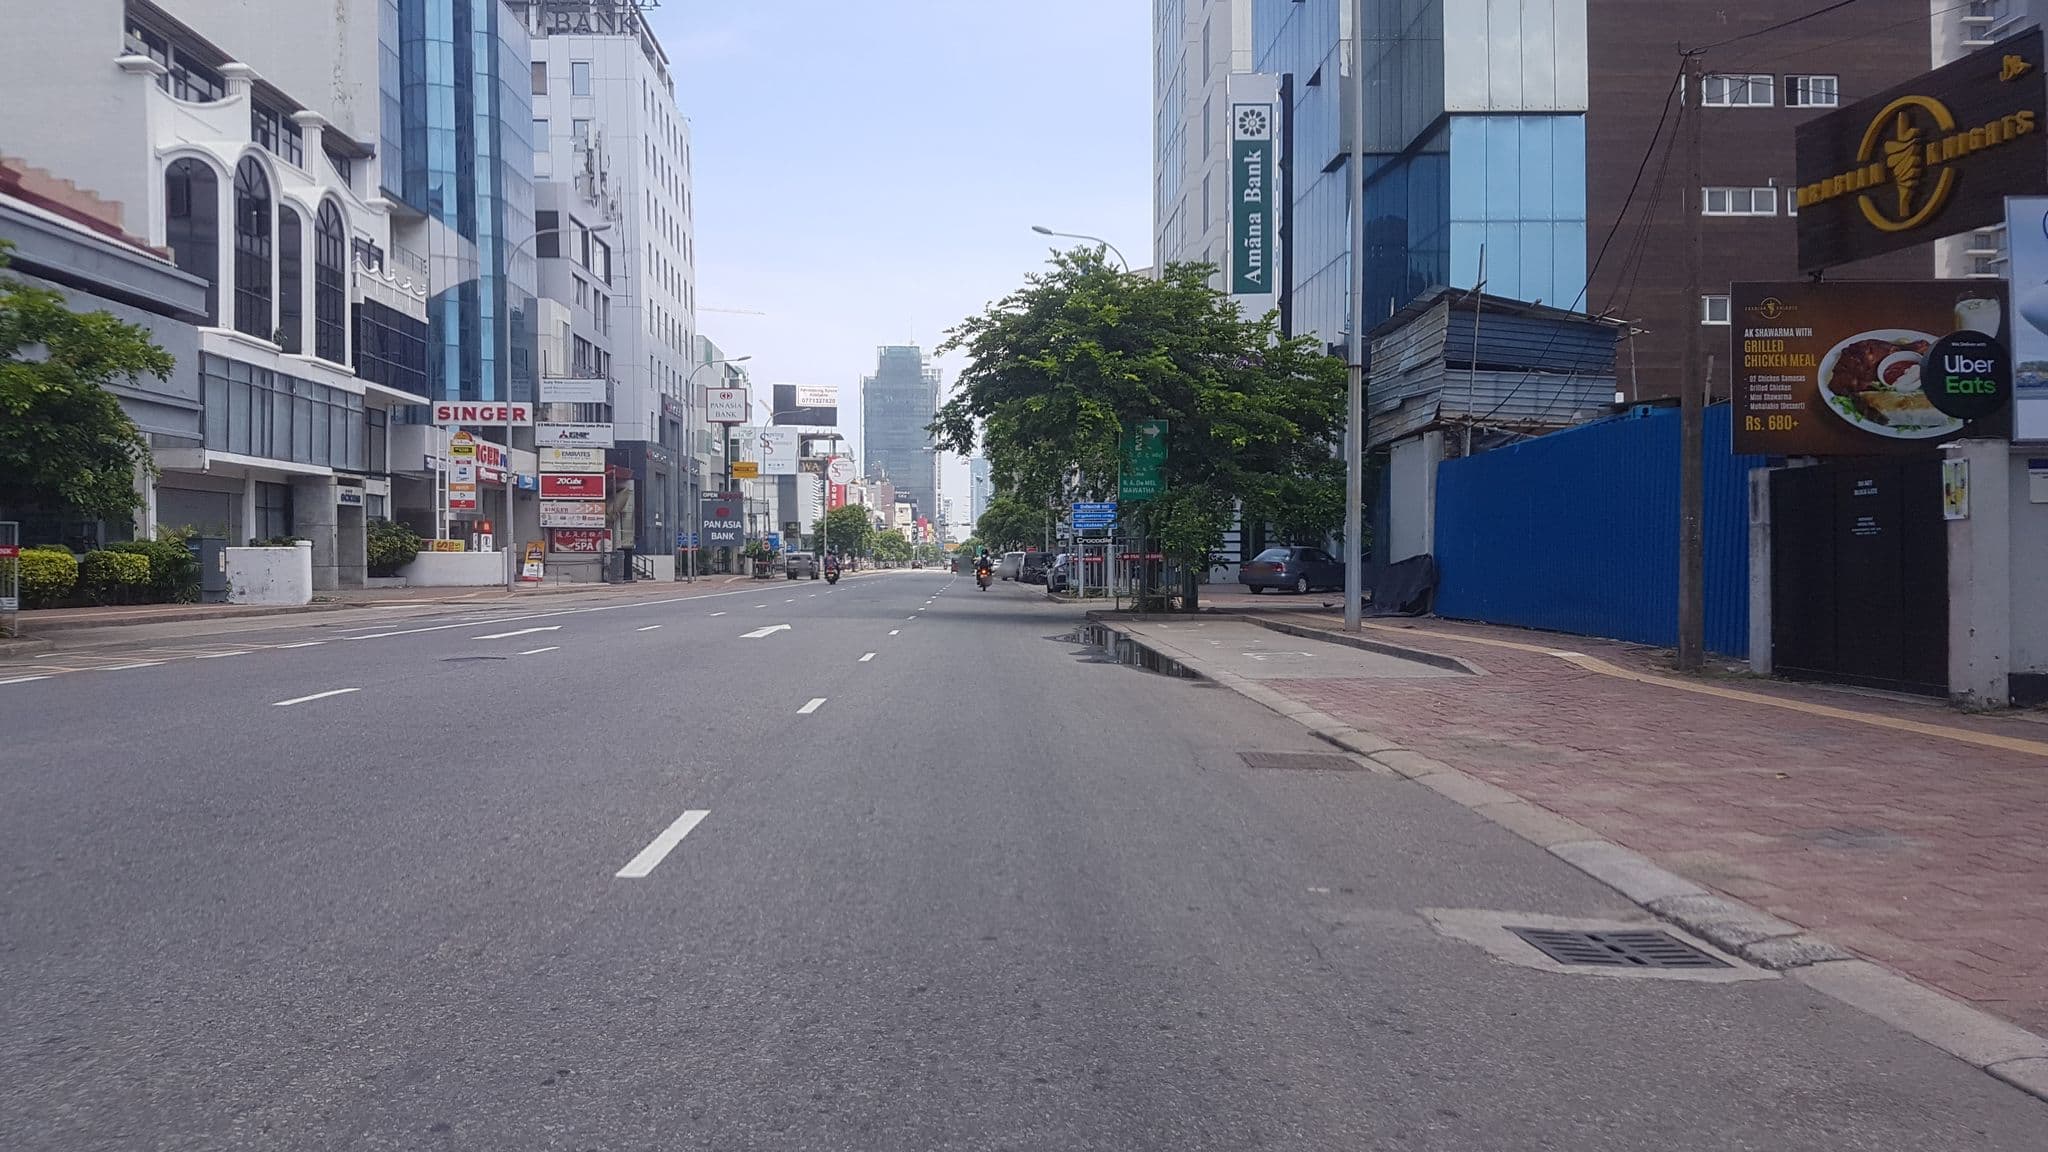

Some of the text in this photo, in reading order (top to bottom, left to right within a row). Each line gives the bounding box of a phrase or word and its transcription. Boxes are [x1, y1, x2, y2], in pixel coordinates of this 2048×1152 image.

[554, 12, 640, 35] BANK
[1243, 149, 1262, 203] Bank
[1744, 327, 1813, 338] AK SHAWARMA WITH
[1744, 339, 1784, 353] GRILLED
[1744, 353, 1816, 367] CHICKEN MEAL
[1944, 355, 1994, 373] Uber
[1945, 376, 1996, 394] Eats
[437, 406, 527, 422] SINGER
[1745, 415, 1799, 431] Rs. 680+
[703, 520, 742, 529] PAN ASIA
[711, 532, 735, 540] BANK
[574, 542, 594, 551] SPA
